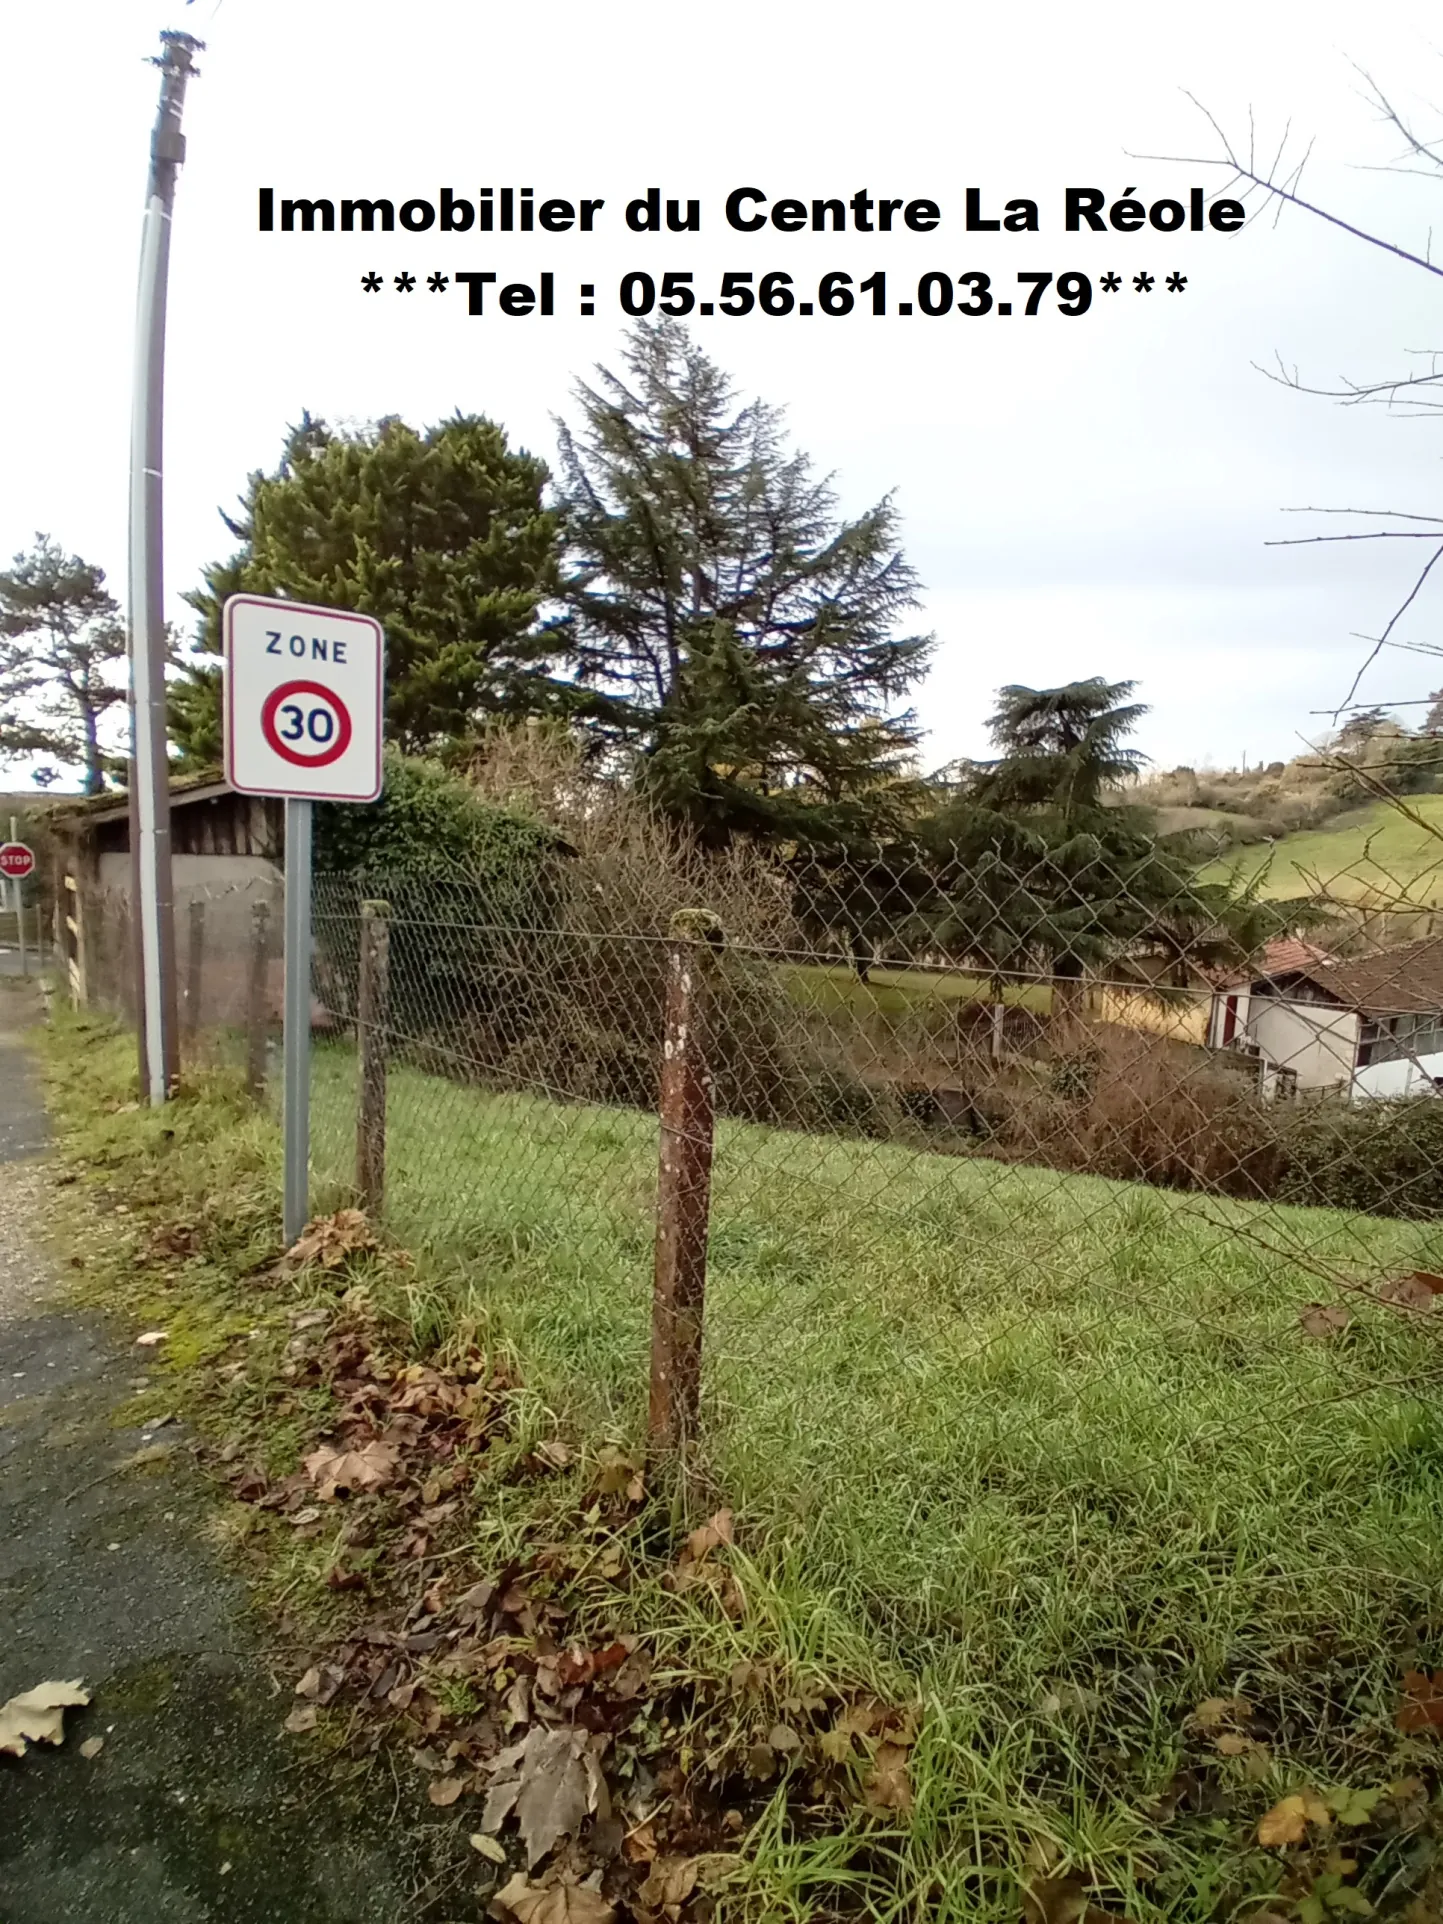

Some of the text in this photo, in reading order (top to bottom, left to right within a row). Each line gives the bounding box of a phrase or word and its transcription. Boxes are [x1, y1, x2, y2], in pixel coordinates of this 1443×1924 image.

[265, 630, 348, 664] ZONE
[280, 704, 334, 743] 30
[0, 855, 31, 866] STOP
